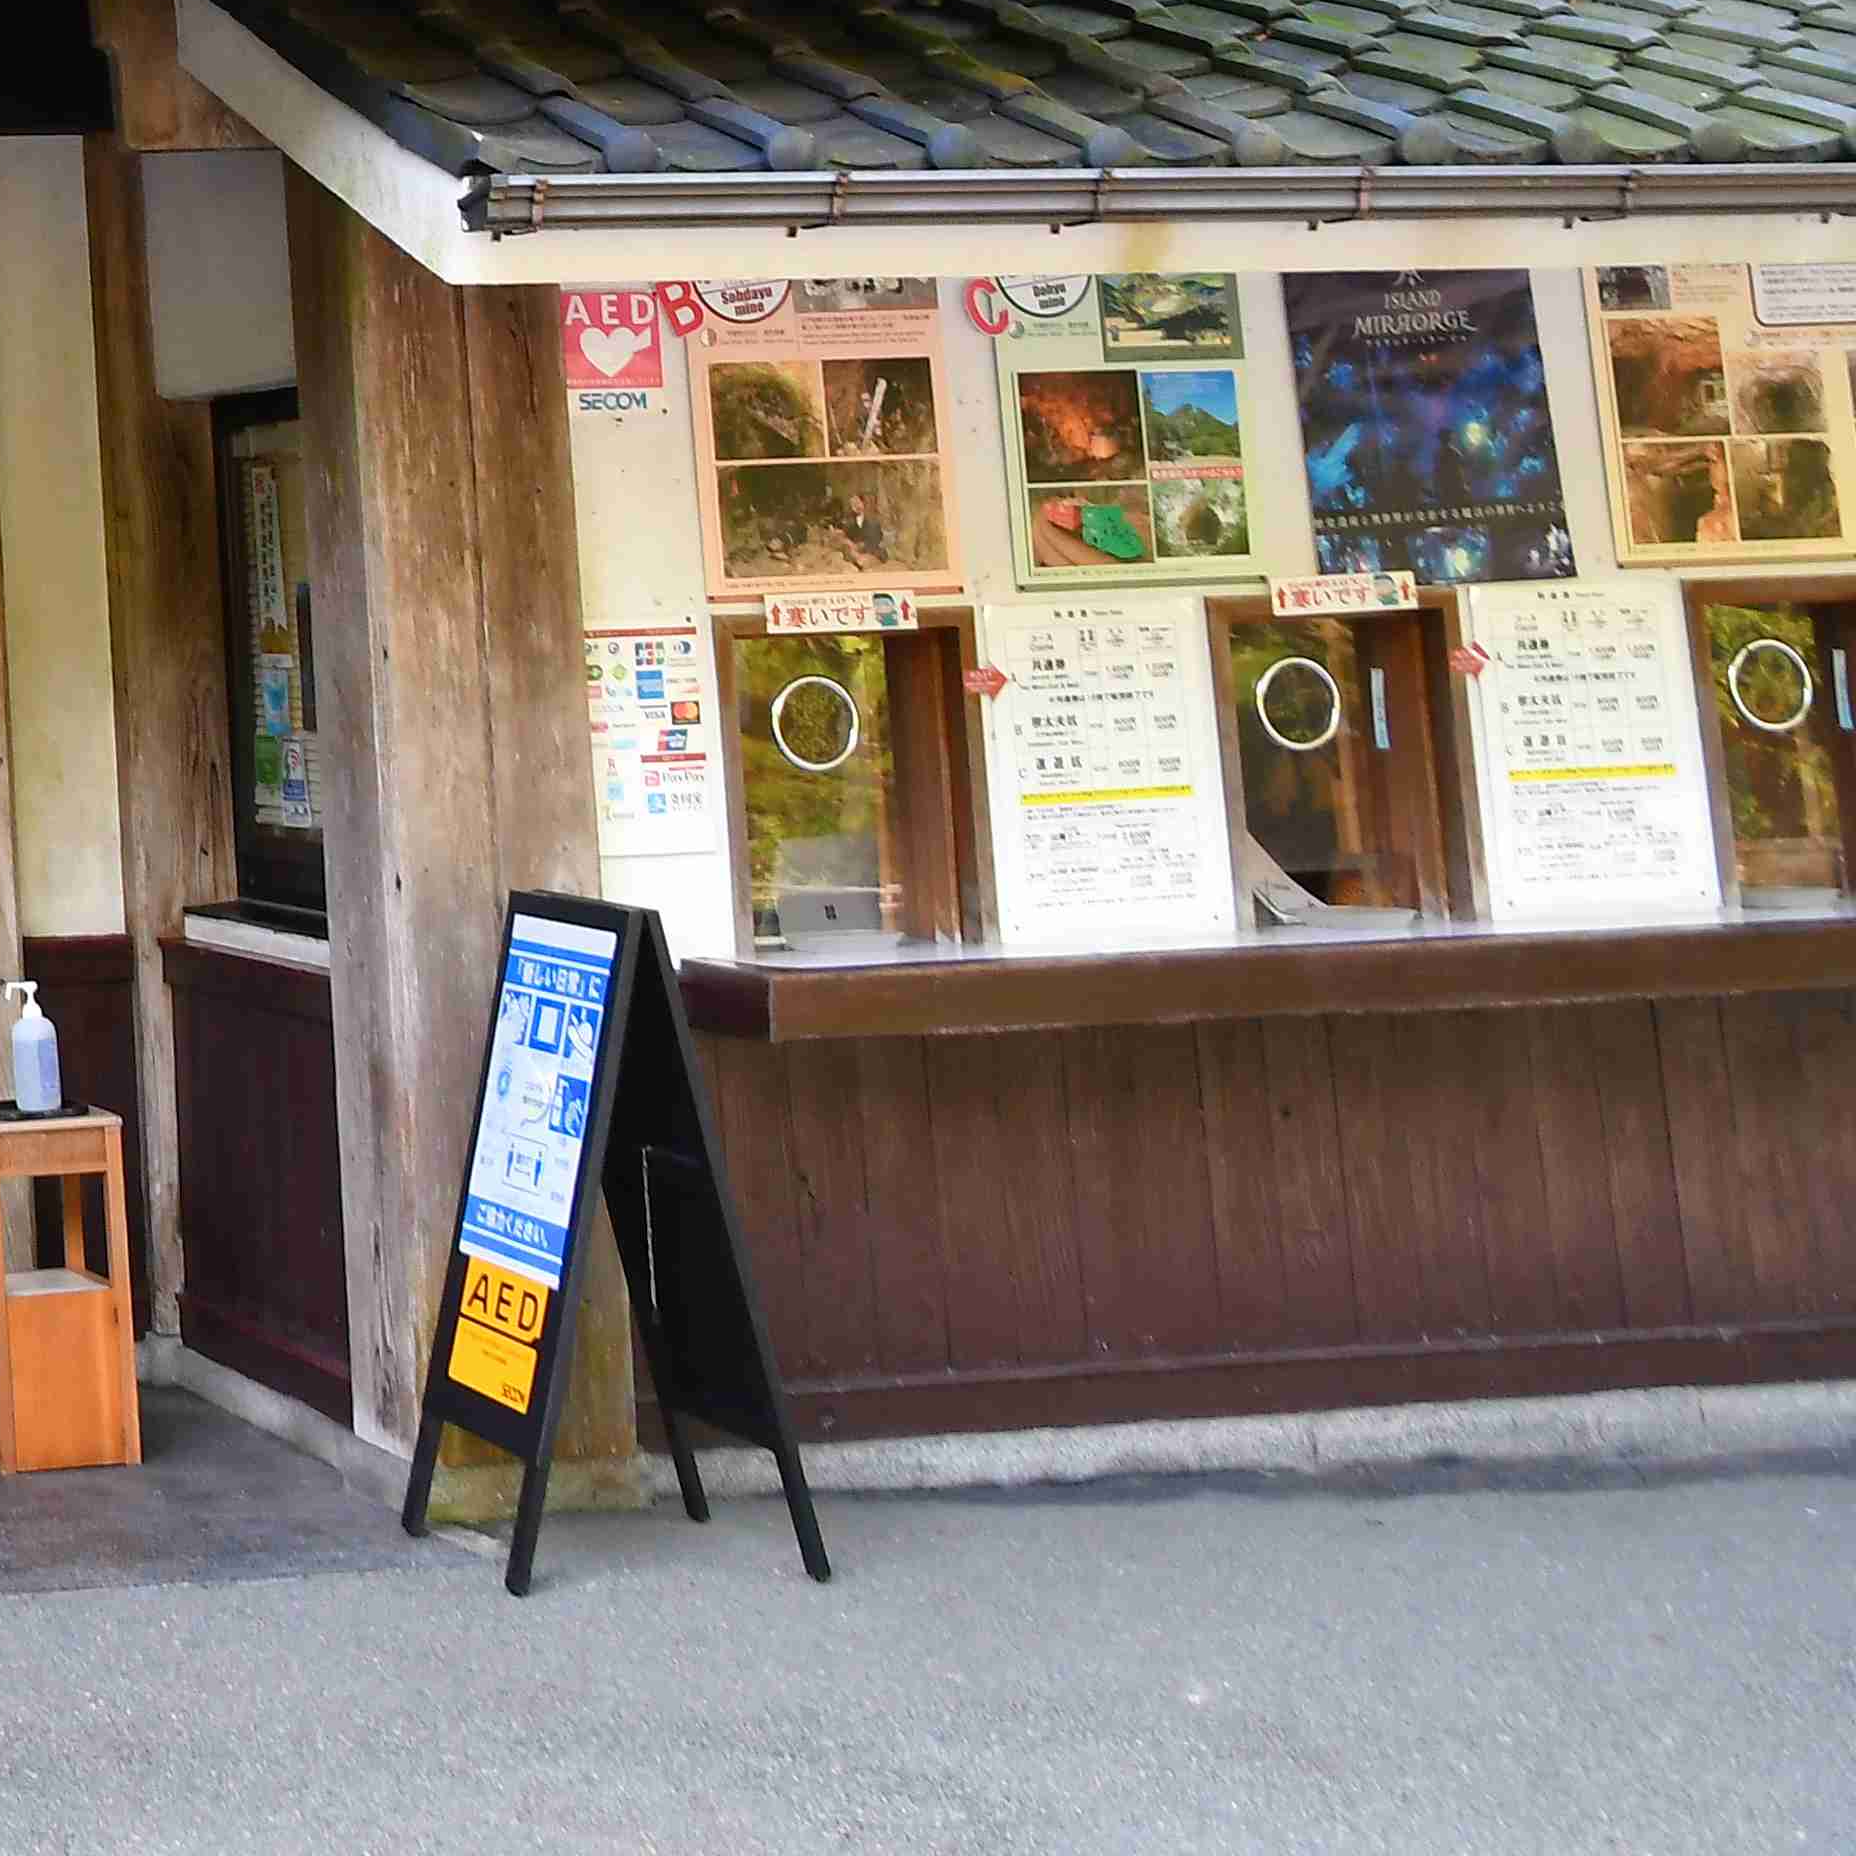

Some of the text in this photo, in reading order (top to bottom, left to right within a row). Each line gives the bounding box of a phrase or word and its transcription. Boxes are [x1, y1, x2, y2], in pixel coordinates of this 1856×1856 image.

[565, 294, 656, 325] AED
[656, 281, 704, 337] B
[963, 277, 1009, 336] C
[1383, 288, 1442, 311] ISLAND
[578, 392, 648, 411] SECOM
[785, 604, 868, 628] 寒いです
[467, 1273, 539, 1333] AED
